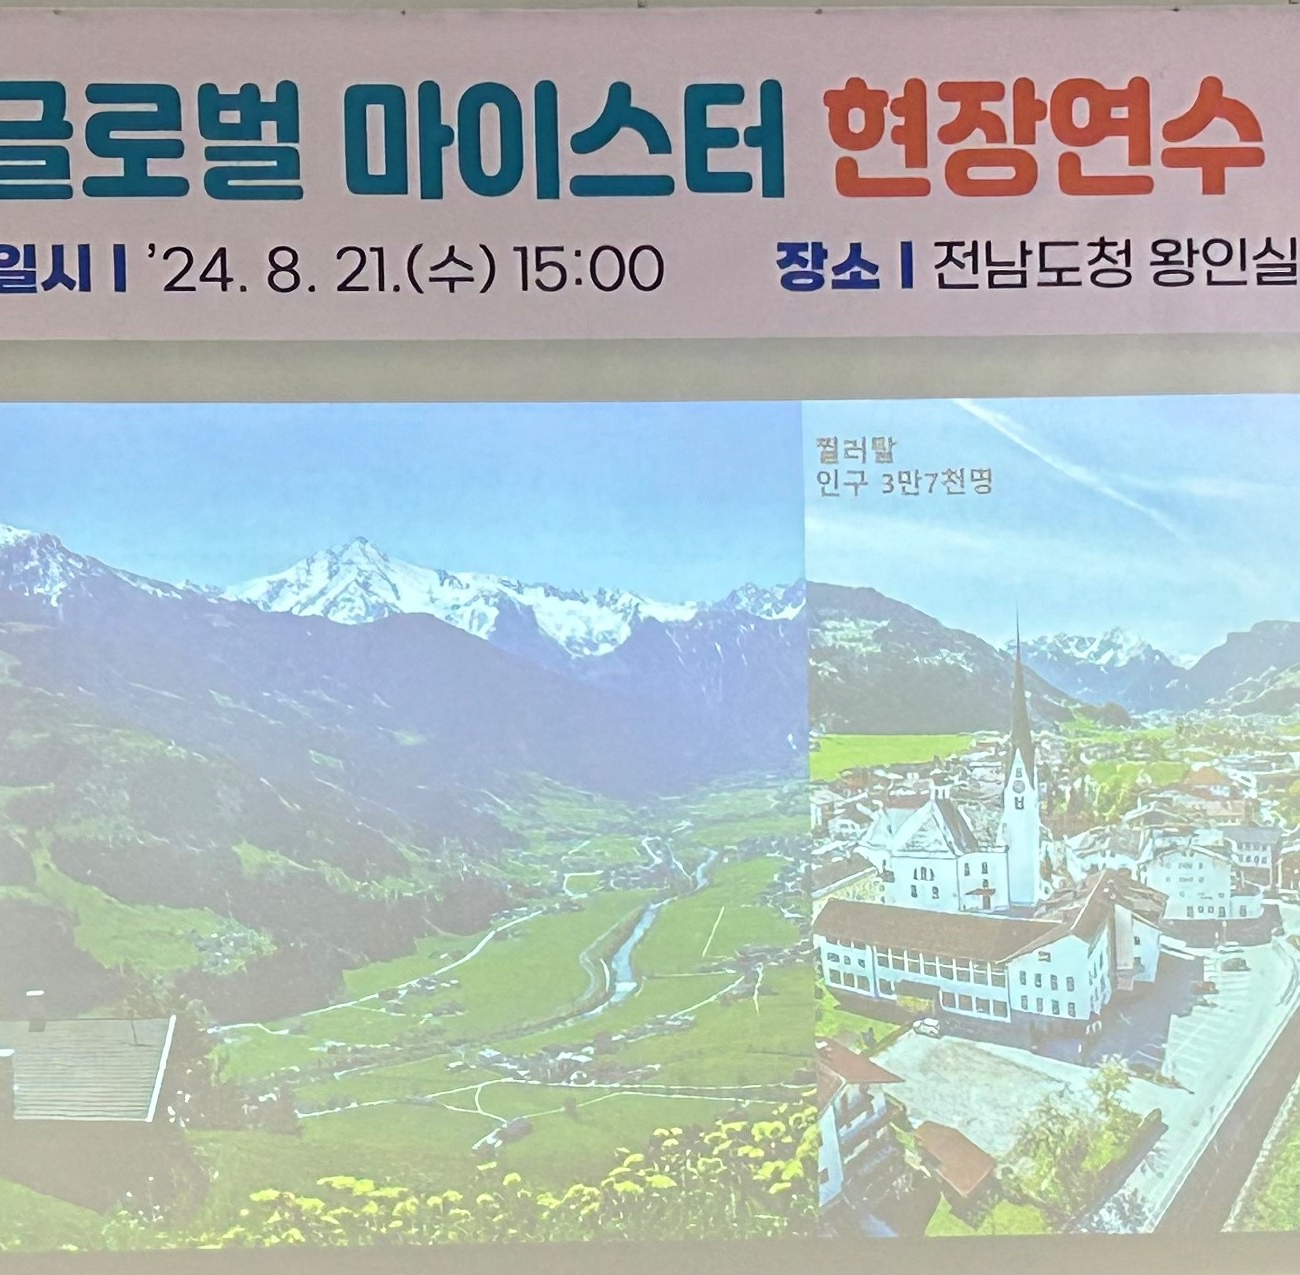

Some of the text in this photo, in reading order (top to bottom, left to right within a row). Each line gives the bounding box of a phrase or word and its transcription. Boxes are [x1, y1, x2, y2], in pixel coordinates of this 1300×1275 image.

[343, 78, 786, 201] 마이스터
[822, 75, 1266, 198] 현장연수
[267, 245, 316, 294] 8.
[335, 242, 496, 295] 21.(수)
[512, 244, 665, 293] 15:00
[775, 235, 1298, 293] 장소 전남도청 왕인실
[816, 467, 993, 498] 인구 3만7천명
